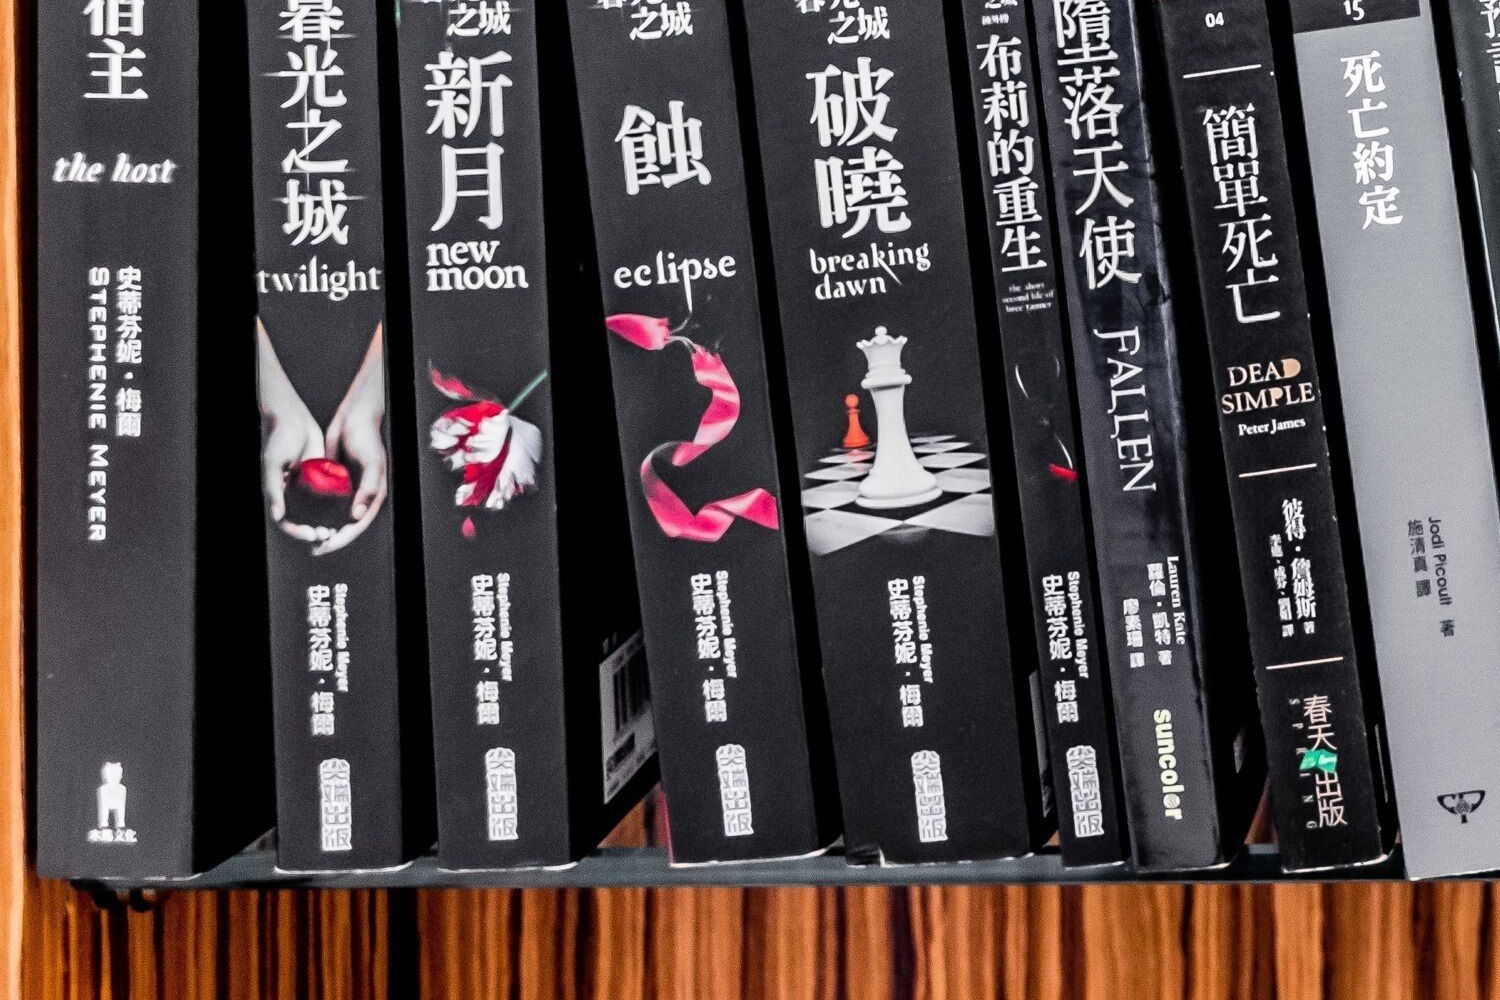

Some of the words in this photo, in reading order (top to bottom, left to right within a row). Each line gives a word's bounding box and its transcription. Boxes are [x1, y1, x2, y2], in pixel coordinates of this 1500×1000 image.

[1205, 12, 1224, 27] 04
[1343, 0, 1364, 20] 15
[423, 50, 513, 232] 新月
[615, 100, 711, 195] 蝕
[806, 57, 911, 238] 破曉
[976, 34, 1047, 272] 布莉的重生
[1340, 50, 1403, 230] 死亡約定
[53, 152, 105, 182] the
[111, 153, 176, 183] host
[1203, 102, 1281, 324] 簡單死亡
[256, 255, 382, 301] twilight
[425, 240, 500, 267] new
[426, 264, 529, 292] moon
[809, 241, 932, 286] breaking
[613, 250, 737, 314] eclipse
[814, 275, 887, 301] dawn
[88, 267, 109, 429] STEPHENIE
[1226, 358, 1301, 387] DEAD
[1093, 326, 1157, 491] FALLEN
[1222, 382, 1315, 414] SIMPLE
[1238, 420, 1270, 436] Peter
[1271, 418, 1306, 434] James
[88, 444, 108, 541] MEYER
[1429, 517, 1444, 549] Jodi
[1166, 556, 1183, 608] Lauren
[1434, 554, 1452, 605] Picoult
[1173, 612, 1186, 645] Kate
[1154, 708, 1185, 820] suncolor
[1303, 694, 1348, 828] 春天出版
